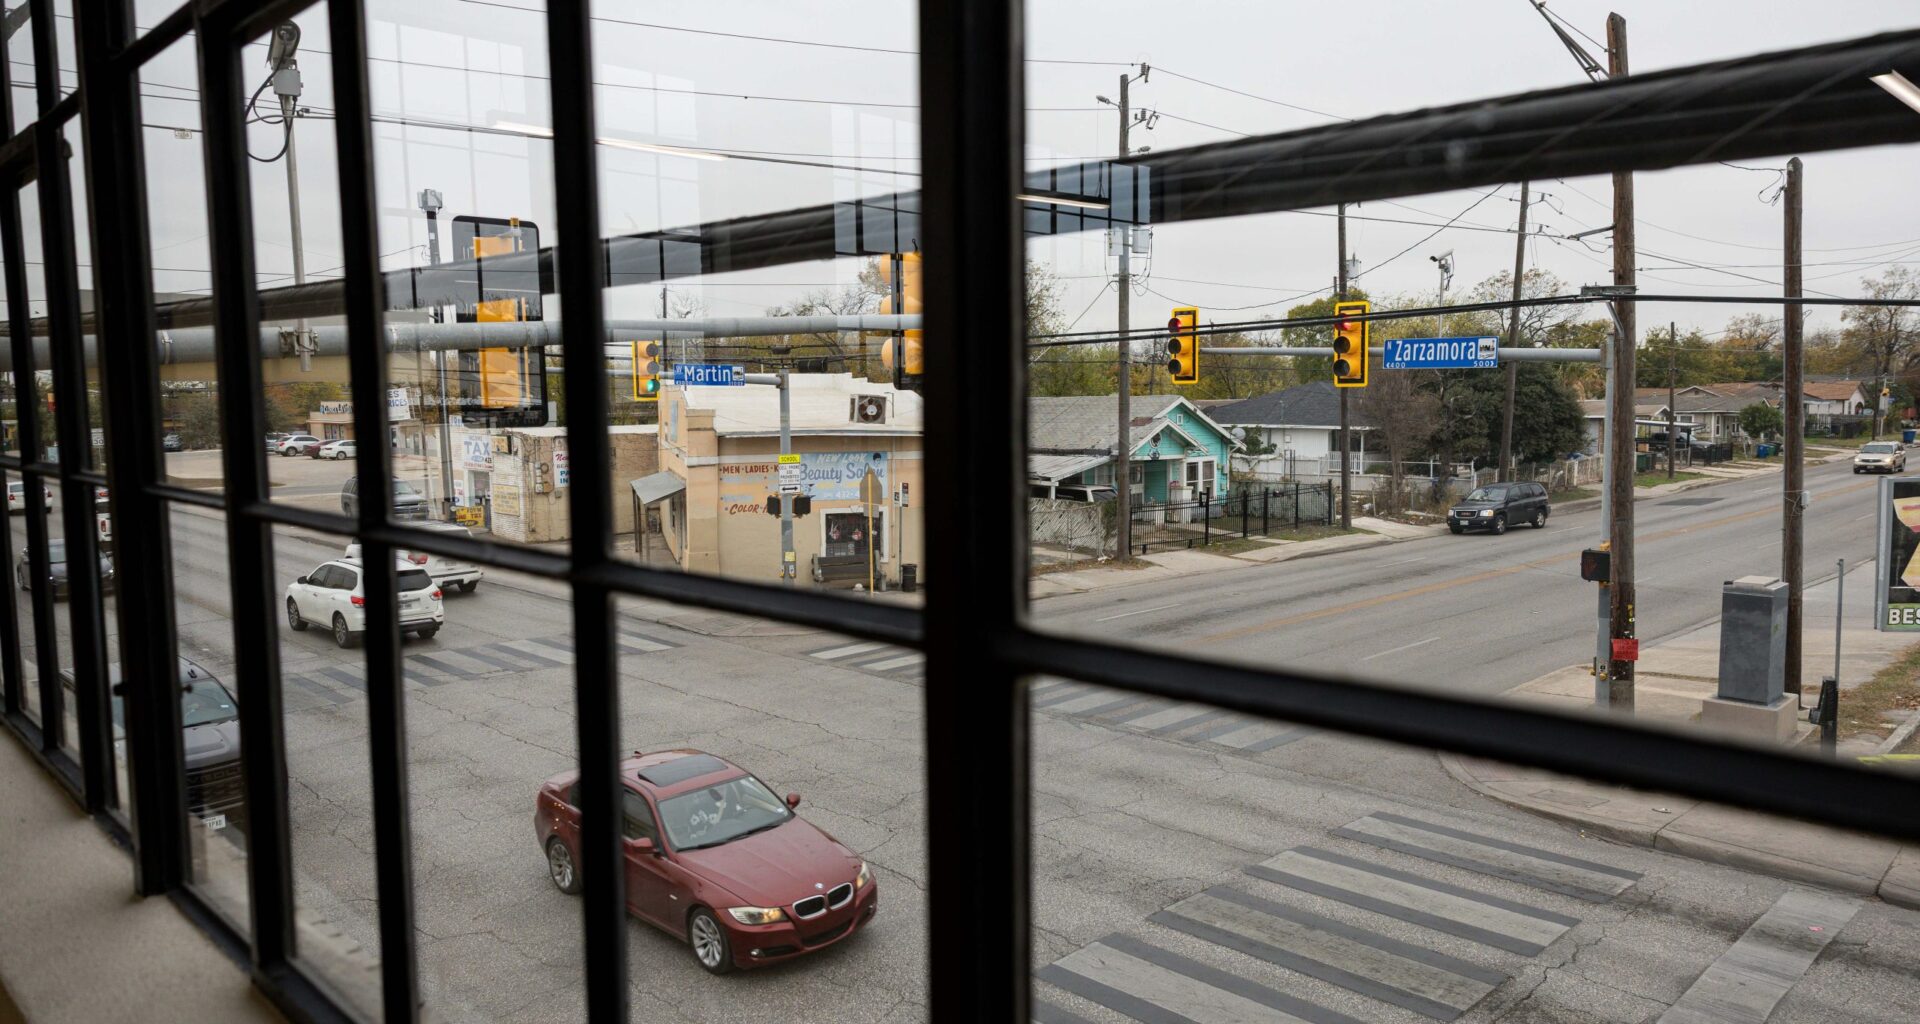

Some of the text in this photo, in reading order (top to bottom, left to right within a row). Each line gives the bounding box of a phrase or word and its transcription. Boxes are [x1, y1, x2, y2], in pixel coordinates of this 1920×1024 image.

[1387, 340, 1476, 362] N Zarzamora
[684, 365, 731, 382] Martin
[464, 441, 490, 456] TAX
[816, 454, 840, 463] NEW
[722, 466, 740, 474] MEN
[745, 465, 769, 473] LADIES
[800, 462, 885, 484] Beauty Saln
[729, 503, 760, 515] COLOR
